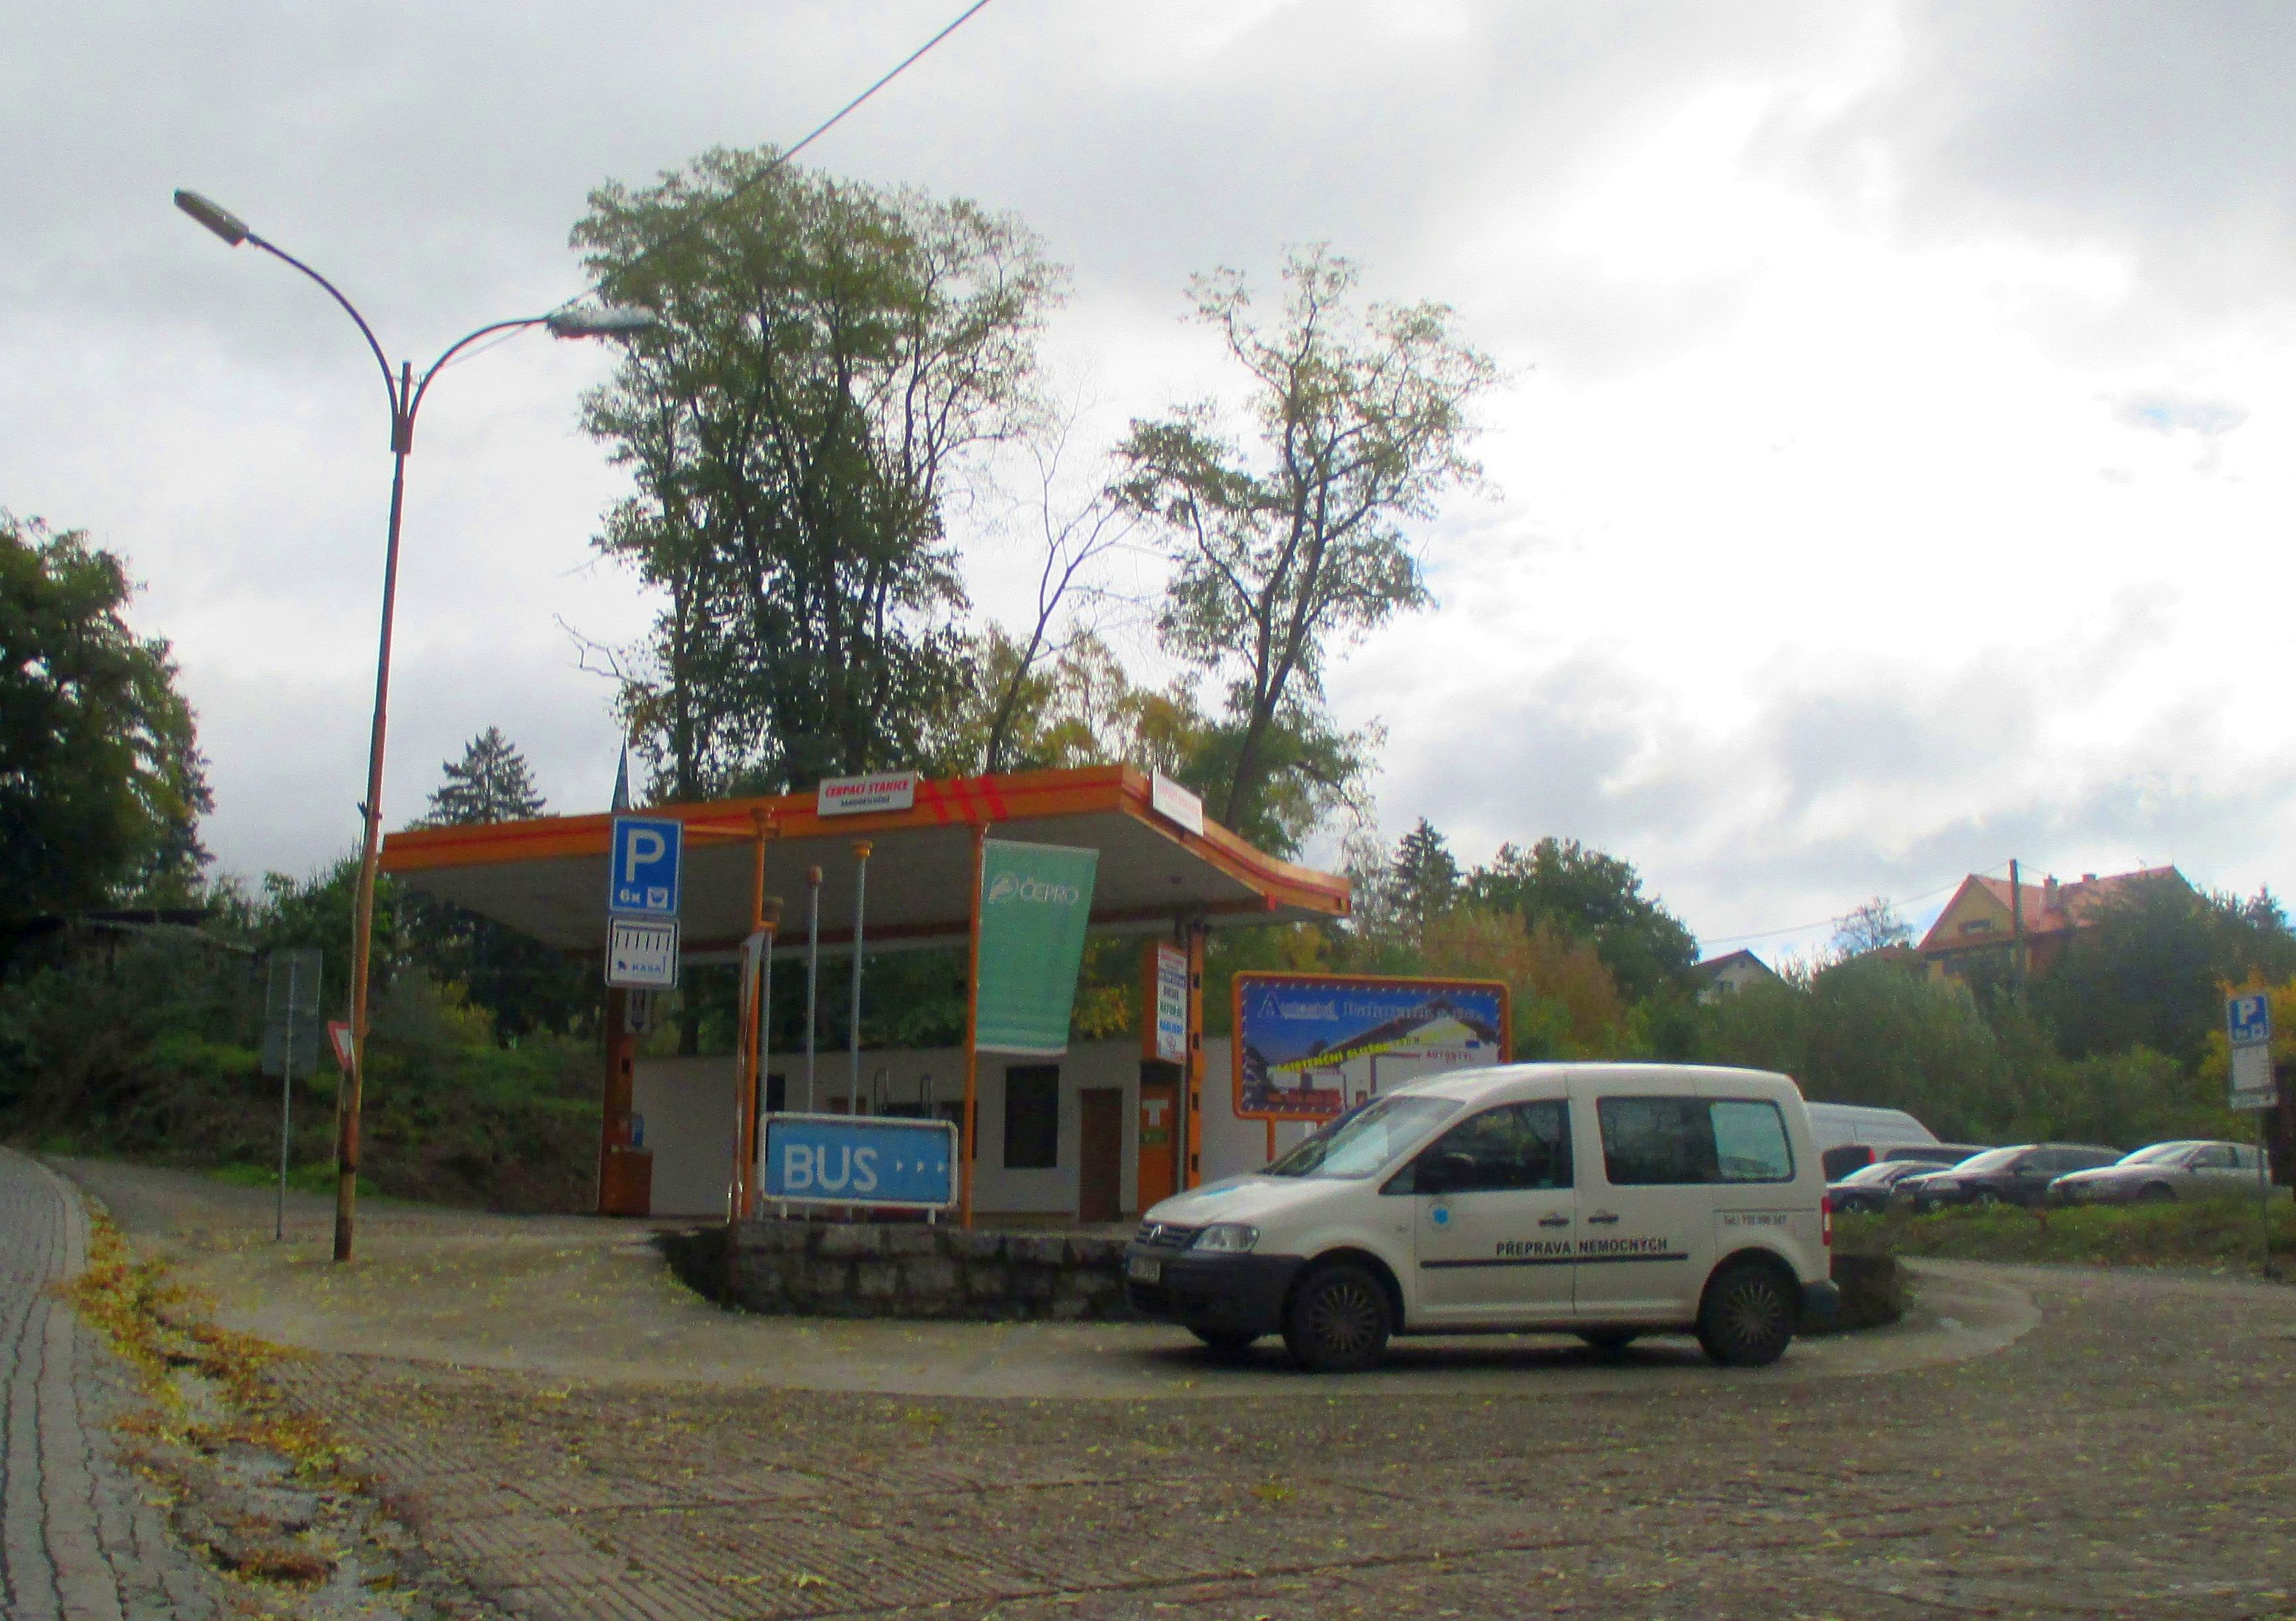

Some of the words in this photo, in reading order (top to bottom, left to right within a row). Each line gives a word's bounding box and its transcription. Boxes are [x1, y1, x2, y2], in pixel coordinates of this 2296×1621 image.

[626, 829, 665, 882] P
[2239, 1000, 2258, 1025] P
[783, 1143, 878, 1192] BUS
